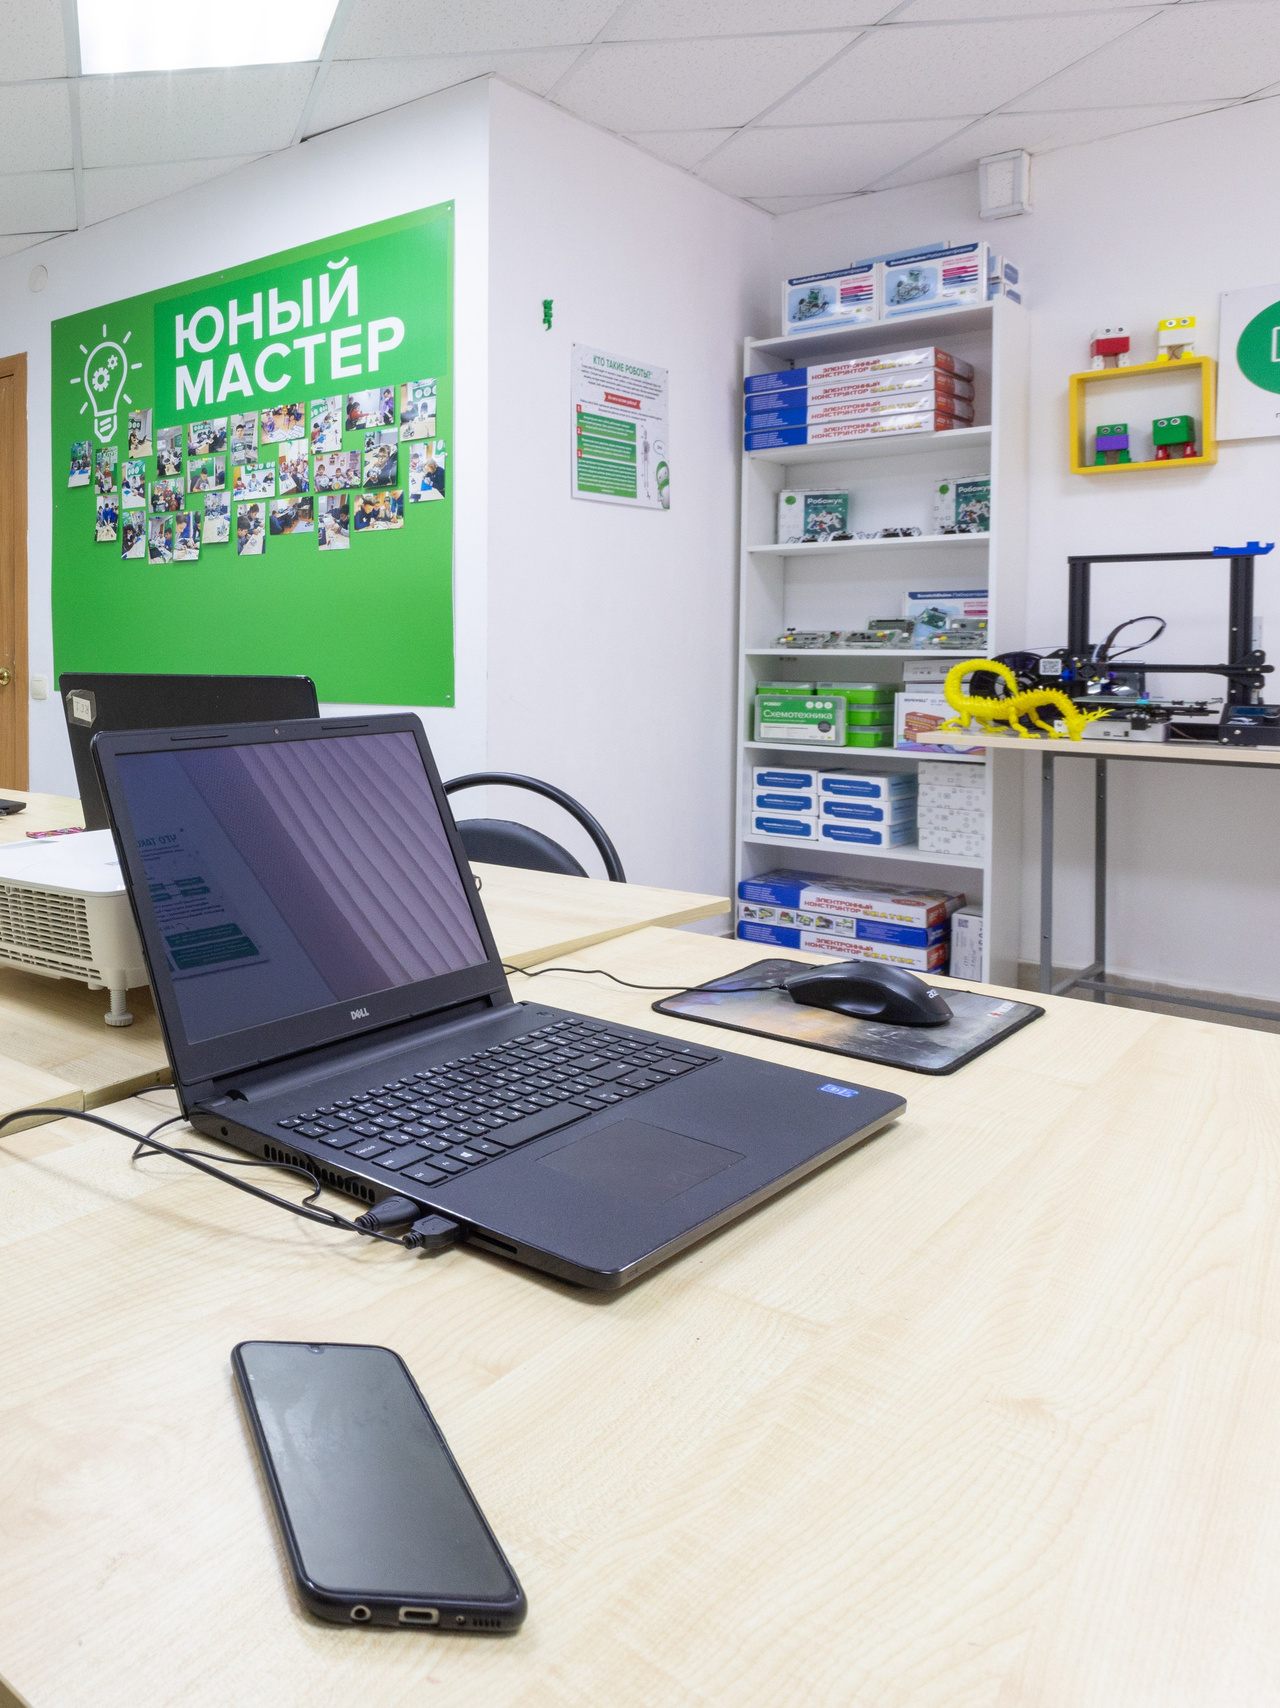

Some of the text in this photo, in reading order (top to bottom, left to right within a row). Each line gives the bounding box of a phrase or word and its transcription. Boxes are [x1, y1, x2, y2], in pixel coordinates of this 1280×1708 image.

[175, 256, 358, 358] ЮНЫЙ
[176, 317, 405, 410] МАСТЕР
[593, 355, 605, 367] КТО
[811, 367, 869, 380] КОНСТРУКТОР
[823, 382, 880, 394] ЭЛЕКТРОННЫЙ
[811, 389, 869, 400] КОНСТРУКТОР
[823, 401, 880, 413] ЭЛЕКТРОННЫЙ
[811, 408, 869, 419] КОНСТРУКТОР
[823, 421, 880, 433] ЭЛЕКТРОННЫЙ
[811, 428, 869, 440] КОНСТРУКТОР
[807, 497, 843, 505] Робожук
[763, 709, 833, 720] Схемотехника
[804, 901, 861, 913] КОНСТРУКТОР
[816, 897, 873, 910] ЭЛЕКТРОННЫЙ
[805, 942, 862, 954] КОНСТРУКТОР
[816, 938, 874, 951] ЭЛЕКТРОННЫЙ
[350, 1007, 369, 1020] DELL
